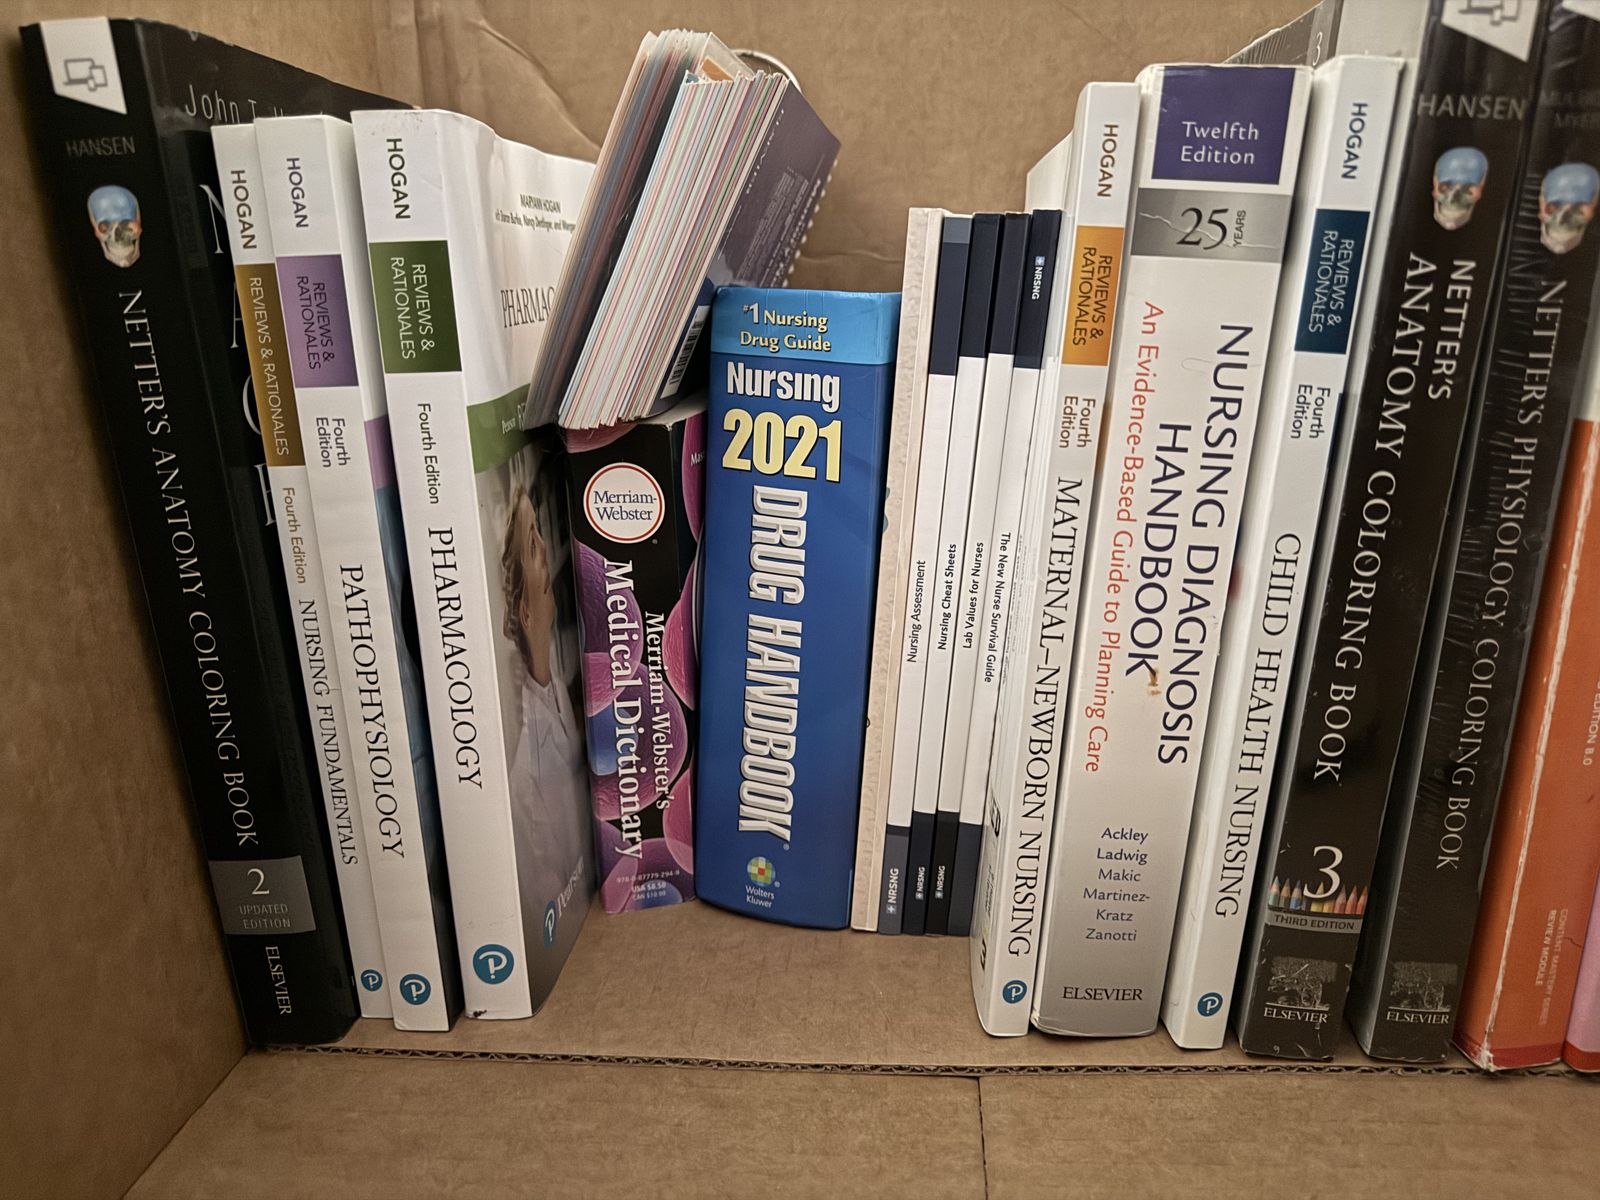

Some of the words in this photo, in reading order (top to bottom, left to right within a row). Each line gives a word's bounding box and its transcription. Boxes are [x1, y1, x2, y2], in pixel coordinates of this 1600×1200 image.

[185, 84, 240, 124] John
[1416, 94, 1526, 122] HANSEN
[66, 136, 136, 158] HANSEN
[1180, 144, 1256, 166] Edition
[1181, 120, 1260, 142] Twelfth
[1341, 101, 1368, 180] HOGAN
[386, 137, 411, 220] HOGAN
[1096, 123, 1119, 198] HOGAN
[230, 169, 257, 251] HOGAN
[286, 157, 309, 229] HOGAN
[1176, 206, 1230, 250] 25
[1232, 209, 1247, 249] YEARS
[1031, 266, 1043, 300] NRSNG
[1072, 246, 1097, 346] RATIONALES
[1091, 255, 1113, 325] REVIEWS
[1308, 230, 1339, 334] RATIONALES
[1331, 238, 1355, 310] REVIEWS
[249, 276, 271, 344] REVIEWS
[296, 275, 321, 370] RATIONALES
[313, 281, 335, 350] REVIEWS
[390, 256, 416, 360] RATIONALES
[411, 263, 434, 335] REVIEWS
[764, 310, 829, 333] Nursing
[1141, 301, 1165, 335] An
[1326, 313, 1342, 327] &
[261, 347, 275, 360] &
[420, 338, 435, 351] &
[740, 330, 780, 353] Drug
[783, 334, 832, 352] Guide
[1089, 328, 1104, 340] &
[1428, 259, 1477, 401] NETTER'S
[1517, 279, 1568, 426] NETTER'S
[323, 351, 336, 363] &
[1374, 251, 1438, 460] ANATOMY
[263, 362, 290, 457] RATIONALES
[727, 361, 841, 414] Nursing
[1290, 384, 1313, 440] Edition
[417, 402, 433, 451] Fourth
[1059, 395, 1079, 449] Edition
[1076, 397, 1096, 448] Fourth
[1116, 344, 1160, 523] Evidence-Based
[1191, 324, 1254, 529] NURSING
[1308, 386, 1331, 440] Fourth
[315, 416, 332, 469] Edition
[331, 417, 348, 467] Fourth
[721, 407, 842, 483] 2021
[424, 454, 440, 505] Edition
[593, 490, 657, 505] Merriam-
[282, 486, 301, 533] Fourth
[595, 506, 654, 522] Webster
[1481, 437, 1538, 626] PHYSIOLOGY
[291, 536, 307, 584] Edition
[748, 484, 809, 606] DRUG
[945, 543, 957, 578] Sheets
[971, 542, 984, 577] Nurses
[996, 554, 1009, 578] New
[999, 532, 1012, 552] The
[1107, 530, 1134, 594] Guide
[1125, 423, 1192, 677] HANDBOOK
[118, 289, 171, 436] NETTER'S
[152, 448, 206, 599] ANATOMY
[188, 611, 240, 761] COLORING
[223, 772, 260, 847] BOOK
[910, 560, 926, 622] Assessment
[968, 578, 980, 595] for
[1262, 532, 1302, 637] CHILD
[1334, 470, 1397, 671] COLORING
[941, 581, 955, 610] Cheat
[965, 594, 978, 629] Values
[992, 580, 1007, 611] Nurse
[1103, 601, 1121, 623] to
[603, 559, 643, 690] Medical
[907, 622, 922, 663] Nursing
[937, 610, 952, 651] Nursing
[962, 630, 974, 649] Lab
[988, 612, 1002, 652] Survival
[428, 526, 483, 790] PHARMACOLOGY
[984, 654, 997, 683] Guide
[1085, 630, 1121, 720] Planning
[1158, 544, 1220, 764] DIAGNOSIS
[298, 599, 330, 697] NURSING
[316, 704, 359, 865] FUNDAMENTALS
[340, 564, 405, 858] PATHOPHYSIOLOGY
[645, 610, 675, 810] Merriam-Webster's
[738, 613, 803, 842] HANDBOOK
[1238, 647, 1283, 776] HEALTH
[1313, 682, 1357, 782] BOOK
[1451, 638, 1500, 786] COLORING
[1085, 725, 1109, 772] Care
[612, 697, 647, 860] Dictionary
[1096, 848, 1148, 866] Ladwig
[1100, 827, 1149, 845] Ackley
[1215, 783, 1259, 918] NURSING
[1436, 796, 1471, 870] BOOK
[246, 867, 271, 896] 2
[745, 885, 775, 900] Wolters
[887, 867, 900, 904] NRSNG
[915, 866, 926, 893] NRSNG
[935, 864, 946, 892] NRSNG
[1008, 830, 1043, 957] NURSING
[1083, 887, 1150, 903] Martinez-
[1098, 868, 1142, 883] Makic
[1303, 845, 1344, 899] 3
[239, 903, 289, 916] UPDATED
[242, 917, 291, 930] EDITION
[746, 895, 773, 908] Kluwer
[1095, 908, 1134, 923] Kratz
[1274, 914, 1308, 928] THIRD
[1310, 918, 1355, 931] EDITION
[1085, 927, 1138, 942] Zanotti
[1543, 909, 1557, 945] REVIEW
[266, 945, 292, 1016] ELSEVIER
[1535, 947, 1549, 986] MODULE
[1062, 985, 1144, 1001] ELSEVIER
[1263, 1006, 1328, 1023] ELSEVIER
[1386, 1010, 1450, 1025] ELSEVIER
